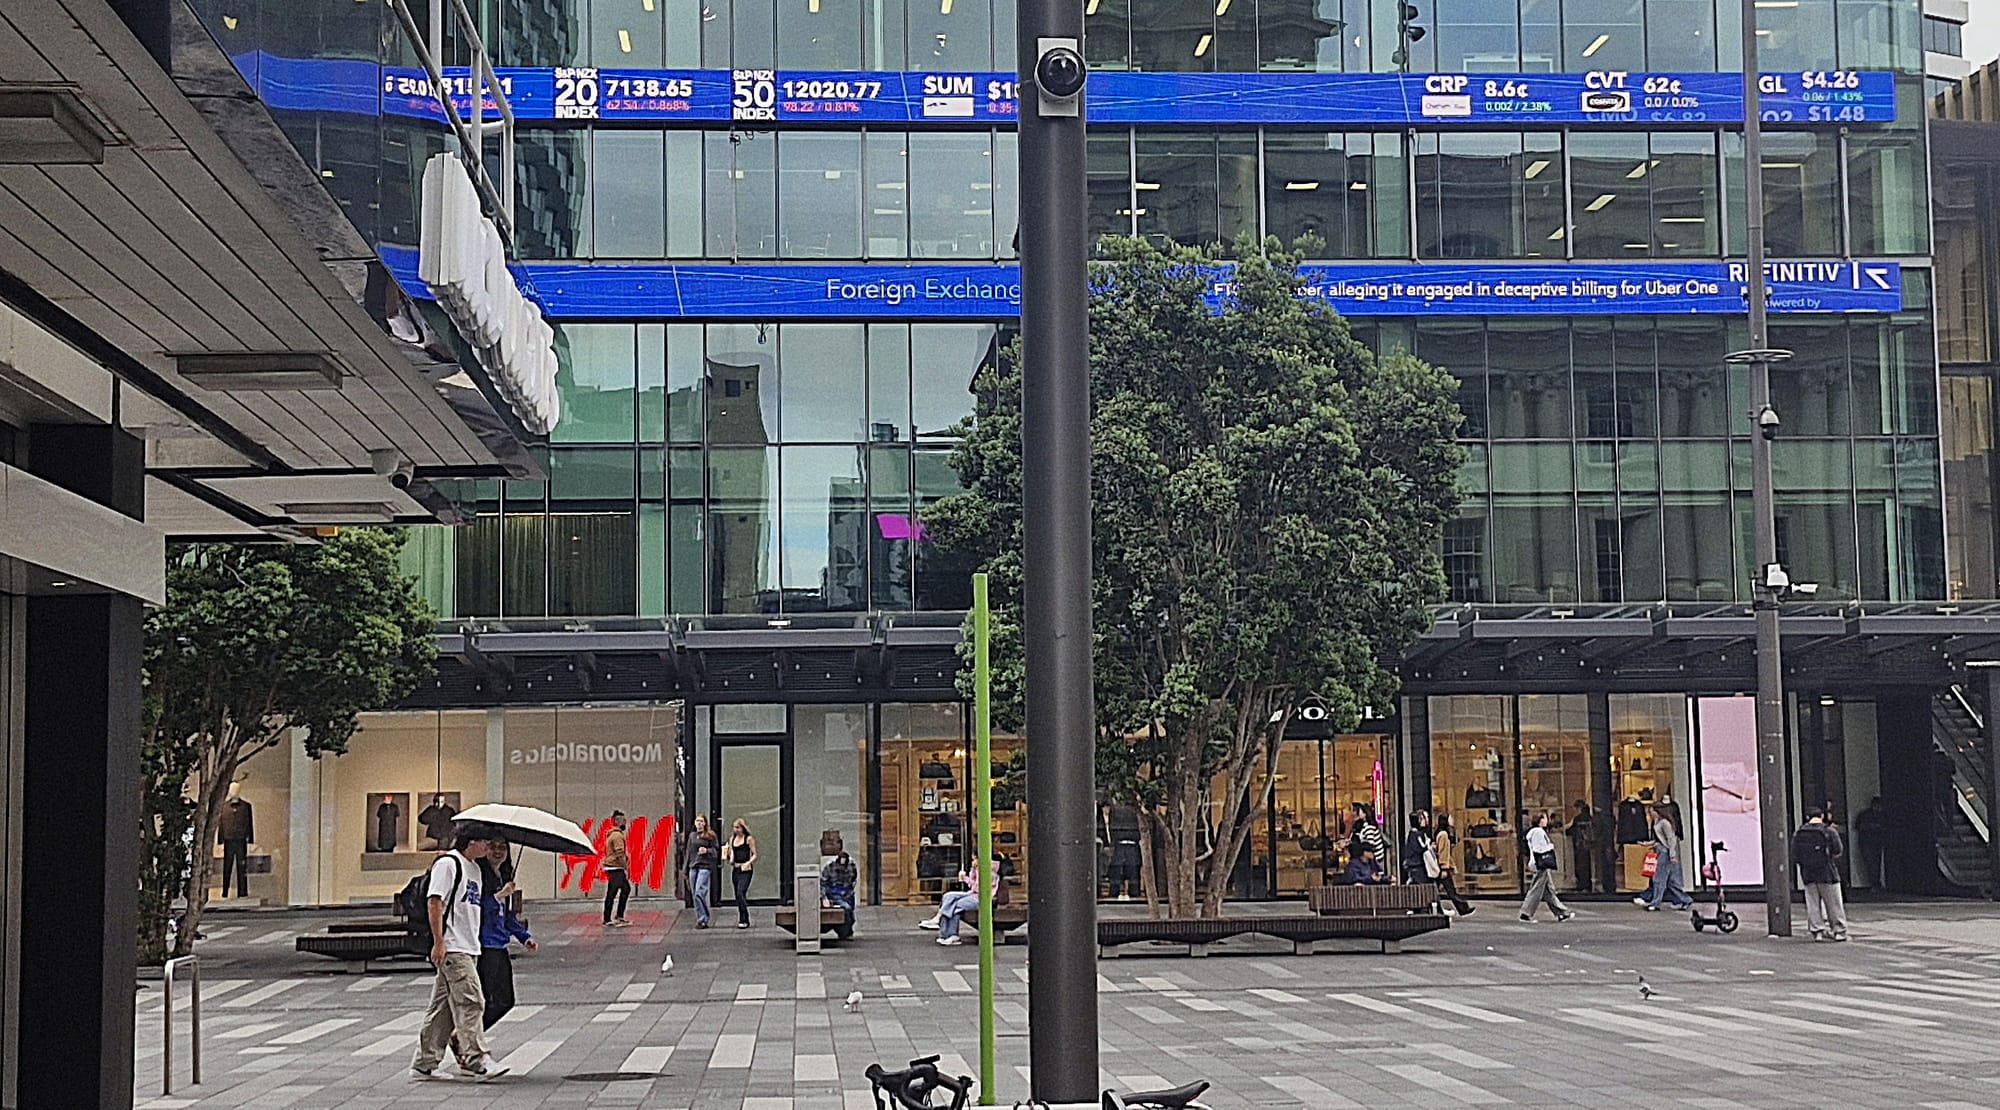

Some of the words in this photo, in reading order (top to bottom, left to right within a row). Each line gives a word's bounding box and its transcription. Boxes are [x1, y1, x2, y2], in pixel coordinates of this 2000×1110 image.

[605, 80, 693, 97] 7138.65
[924, 75, 973, 95] SUM
[1425, 76, 1468, 93] CRP
[1484, 80, 1529, 98] 8.6¢
[1585, 72, 1627, 89] CVT
[1643, 77, 1681, 95] 62¢
[1759, 76, 1787, 93] GL
[1802, 72, 1859, 89] $4.26
[555, 79, 598, 106] 20
[733, 81, 776, 108] 50
[783, 81, 881, 99] 12020.77
[1485, 101, 1513, 111] 0.002
[1521, 101, 1552, 111] 2.38%
[1644, 97, 1661, 108] 0.0
[1671, 97, 1699, 108] 0.0%
[555, 106, 599, 119] INDEX
[734, 108, 776, 120] INDEX
[1808, 106, 1865, 122] $1.48
[827, 279, 916, 305] Foreign
[925, 277, 1021, 305] Exchang
[1329, 282, 1389, 301] alleging
[1392, 281, 1403, 297] it
[1406, 281, 1473, 301] engaged
[1478, 281, 1491, 296] in
[1494, 280, 1567, 301] deceptive
[1572, 280, 1617, 299] billing
[1621, 279, 1642, 296] for
[1645, 279, 1682, 296] Uber
[1685, 279, 1719, 295] One
[1807, 296, 1821, 309] by
